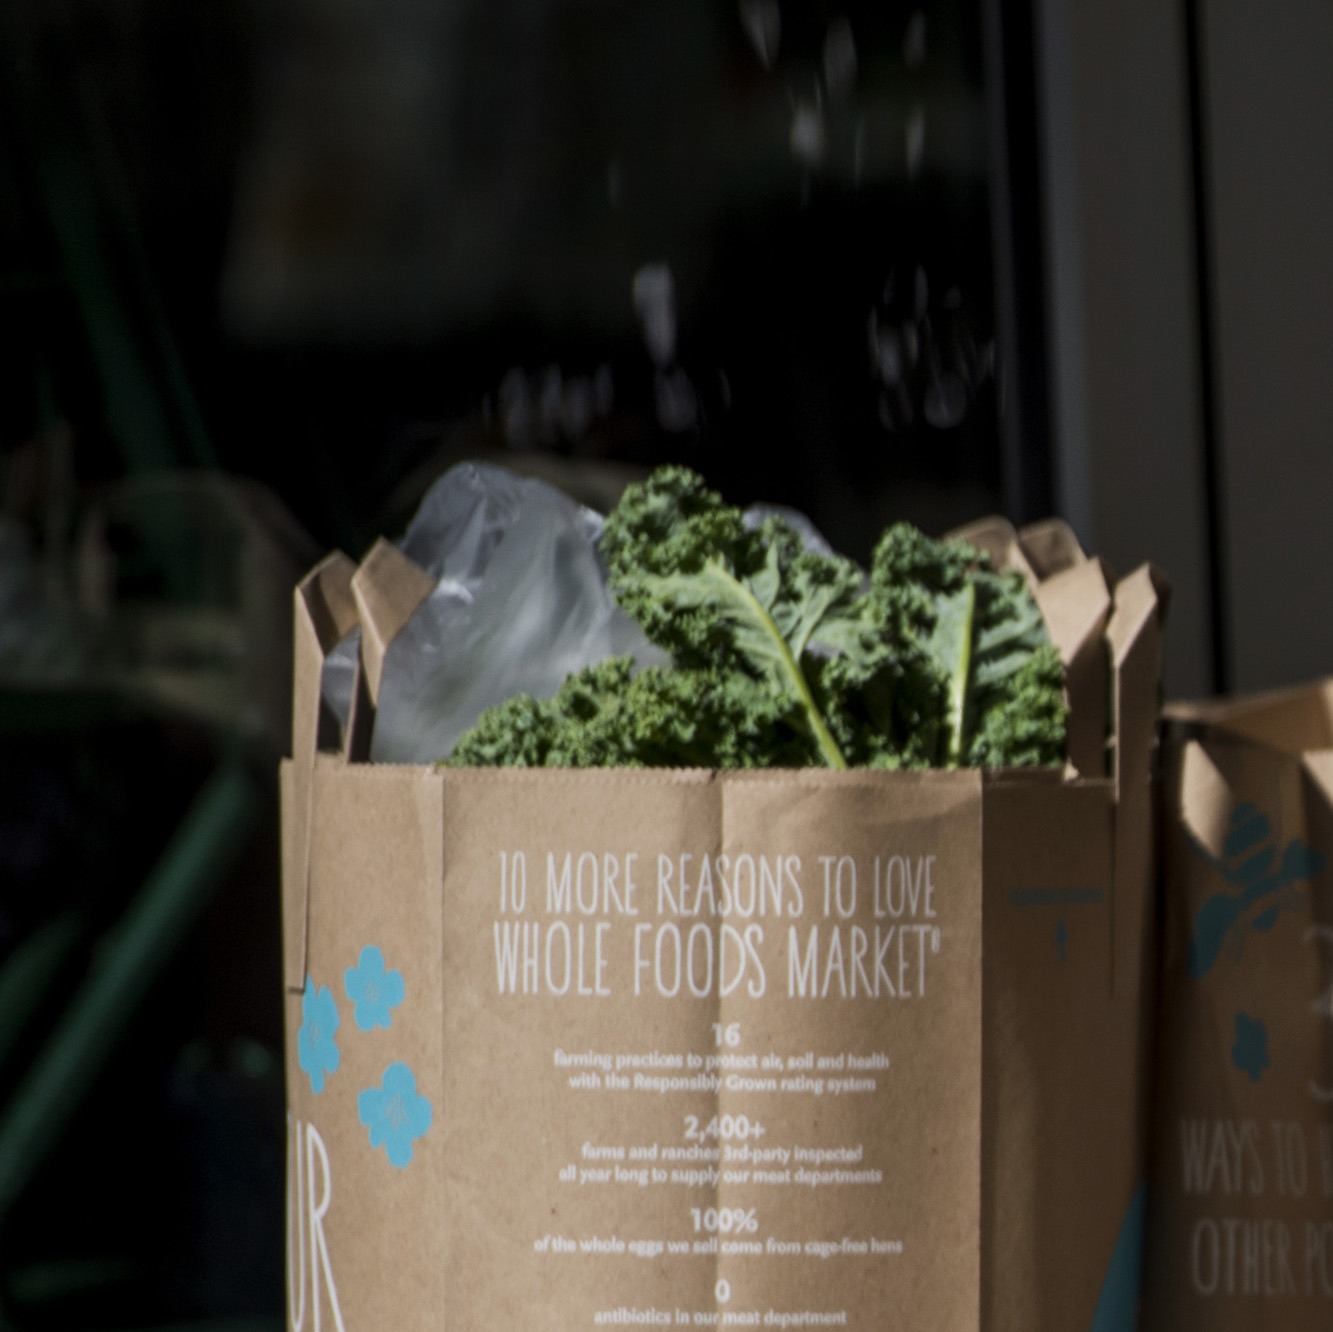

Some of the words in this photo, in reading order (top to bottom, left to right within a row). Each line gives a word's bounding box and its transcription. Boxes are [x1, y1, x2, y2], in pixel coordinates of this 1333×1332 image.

[498, 851, 527, 915] 10
[546, 852, 639, 917] MORE
[658, 853, 804, 918] REASONS
[820, 856, 856, 918] TO
[875, 856, 938, 918] LOVE
[493, 922, 611, 996] WHOLE
[633, 923, 766, 998] FOODS
[712, 1023, 741, 1047] 16
[554, 1050, 611, 1071] farming
[616, 1051, 683, 1072] practices
[687, 1051, 701, 1068] to
[706, 1051, 757, 1072] protect
[788, 1051, 812, 1069] soil
[818, 1052, 844, 1069] and
[848, 1052, 889, 1069] health
[569, 1071, 600, 1089] with
[605, 1072, 629, 1089] the
[634, 1072, 723, 1093] Responsibly
[727, 1073, 776, 1090] Grown
[781, 1073, 823, 1094] rating
[828, 1073, 876, 1094] system
[684, 1115, 766, 1142] 2,400+
[582, 1143, 625, 1161] farms
[630, 1143, 657, 1161] and
[662, 1144, 720, 1161] ranches
[795, 1144, 862, 1165] inspected
[1180, 1118, 1264, 1195] WAYS
[1268, 1120, 1307, 1197] TO
[691, 1207, 758, 1232] 100%
[1190, 1217, 1297, 1296] OTHER
[594, 1308, 671, 1325] antibiotics
[676, 1308, 689, 1325] in
[694, 1311, 719, 1325] our
[723, 1308, 760, 1325] meat
[764, 1308, 847, 1329] department
